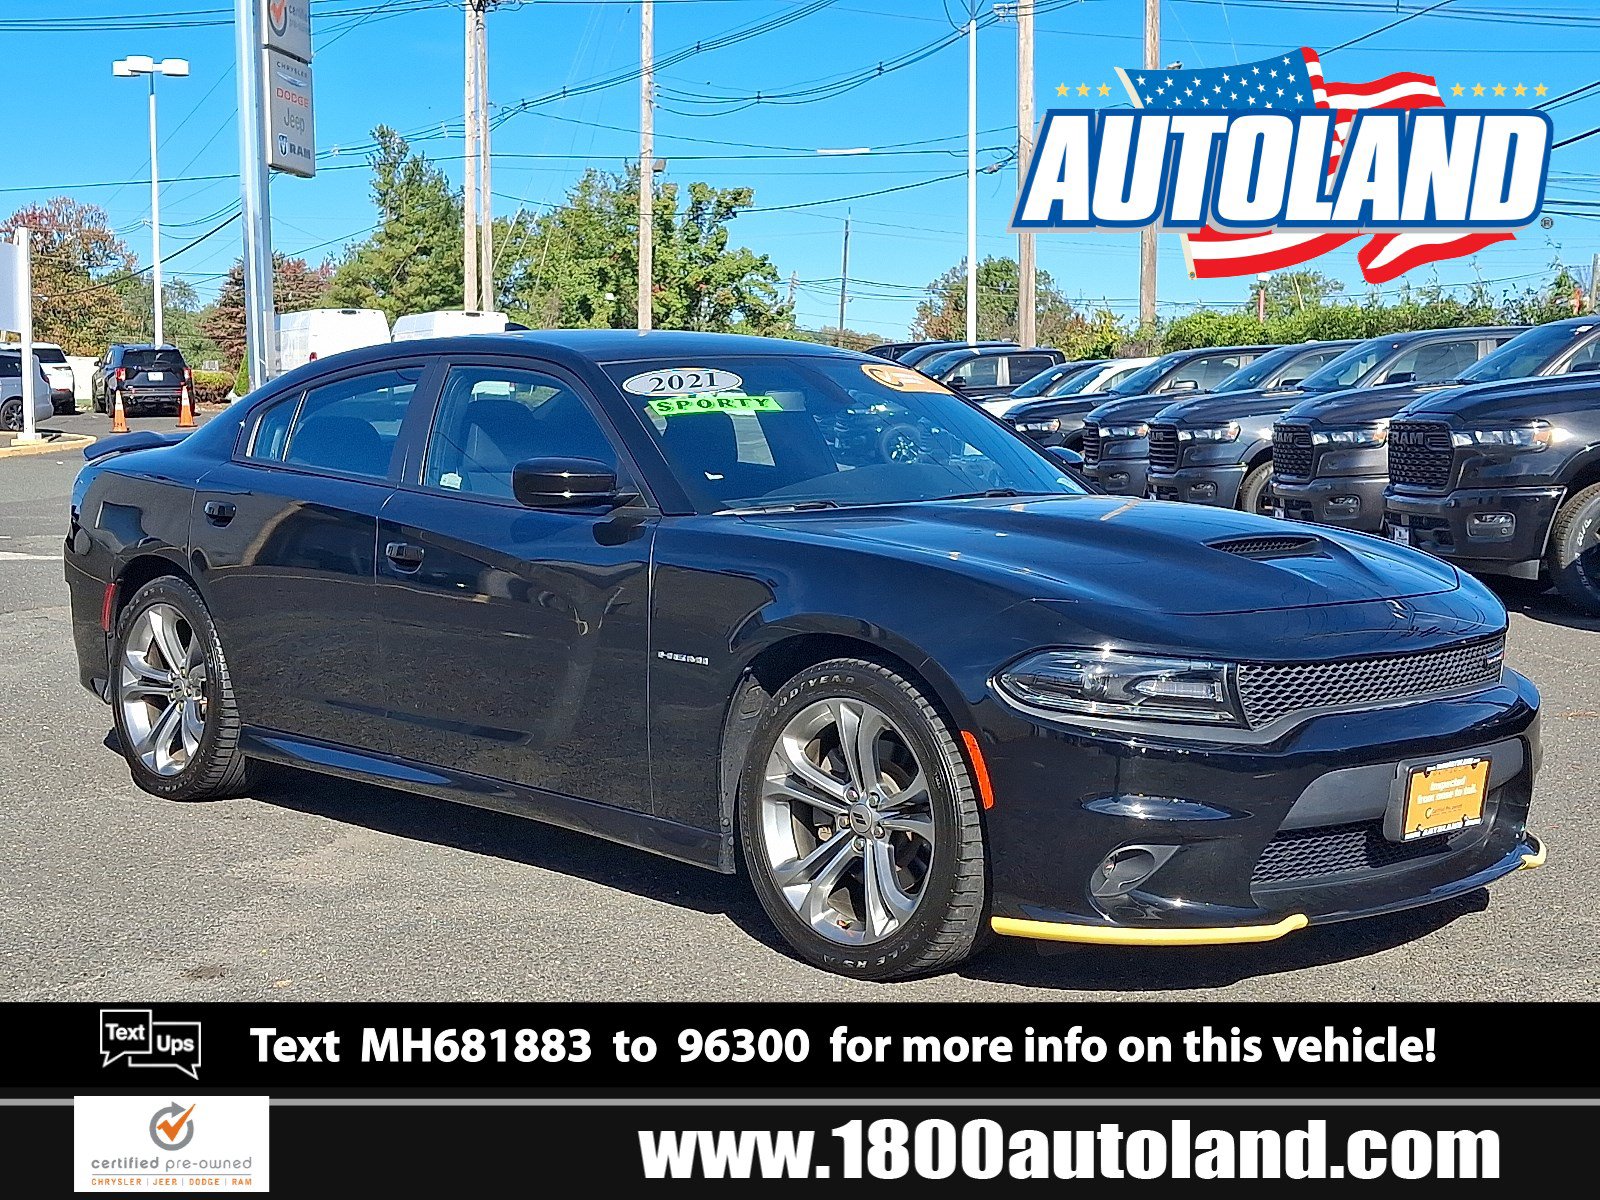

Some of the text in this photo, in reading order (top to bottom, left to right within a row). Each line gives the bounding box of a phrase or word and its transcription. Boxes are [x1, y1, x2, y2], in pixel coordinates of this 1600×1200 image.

[276, 61, 308, 79] CHRYSLER
[276, 87, 309, 108] DODGE
[283, 107, 305, 135] Jeep
[289, 142, 311, 160] RAM
[649, 372, 719, 392] 2021
[657, 396, 770, 412] SPORTY
[1390, 431, 1424, 445] RAM
[657, 650, 709, 665] HEMI
